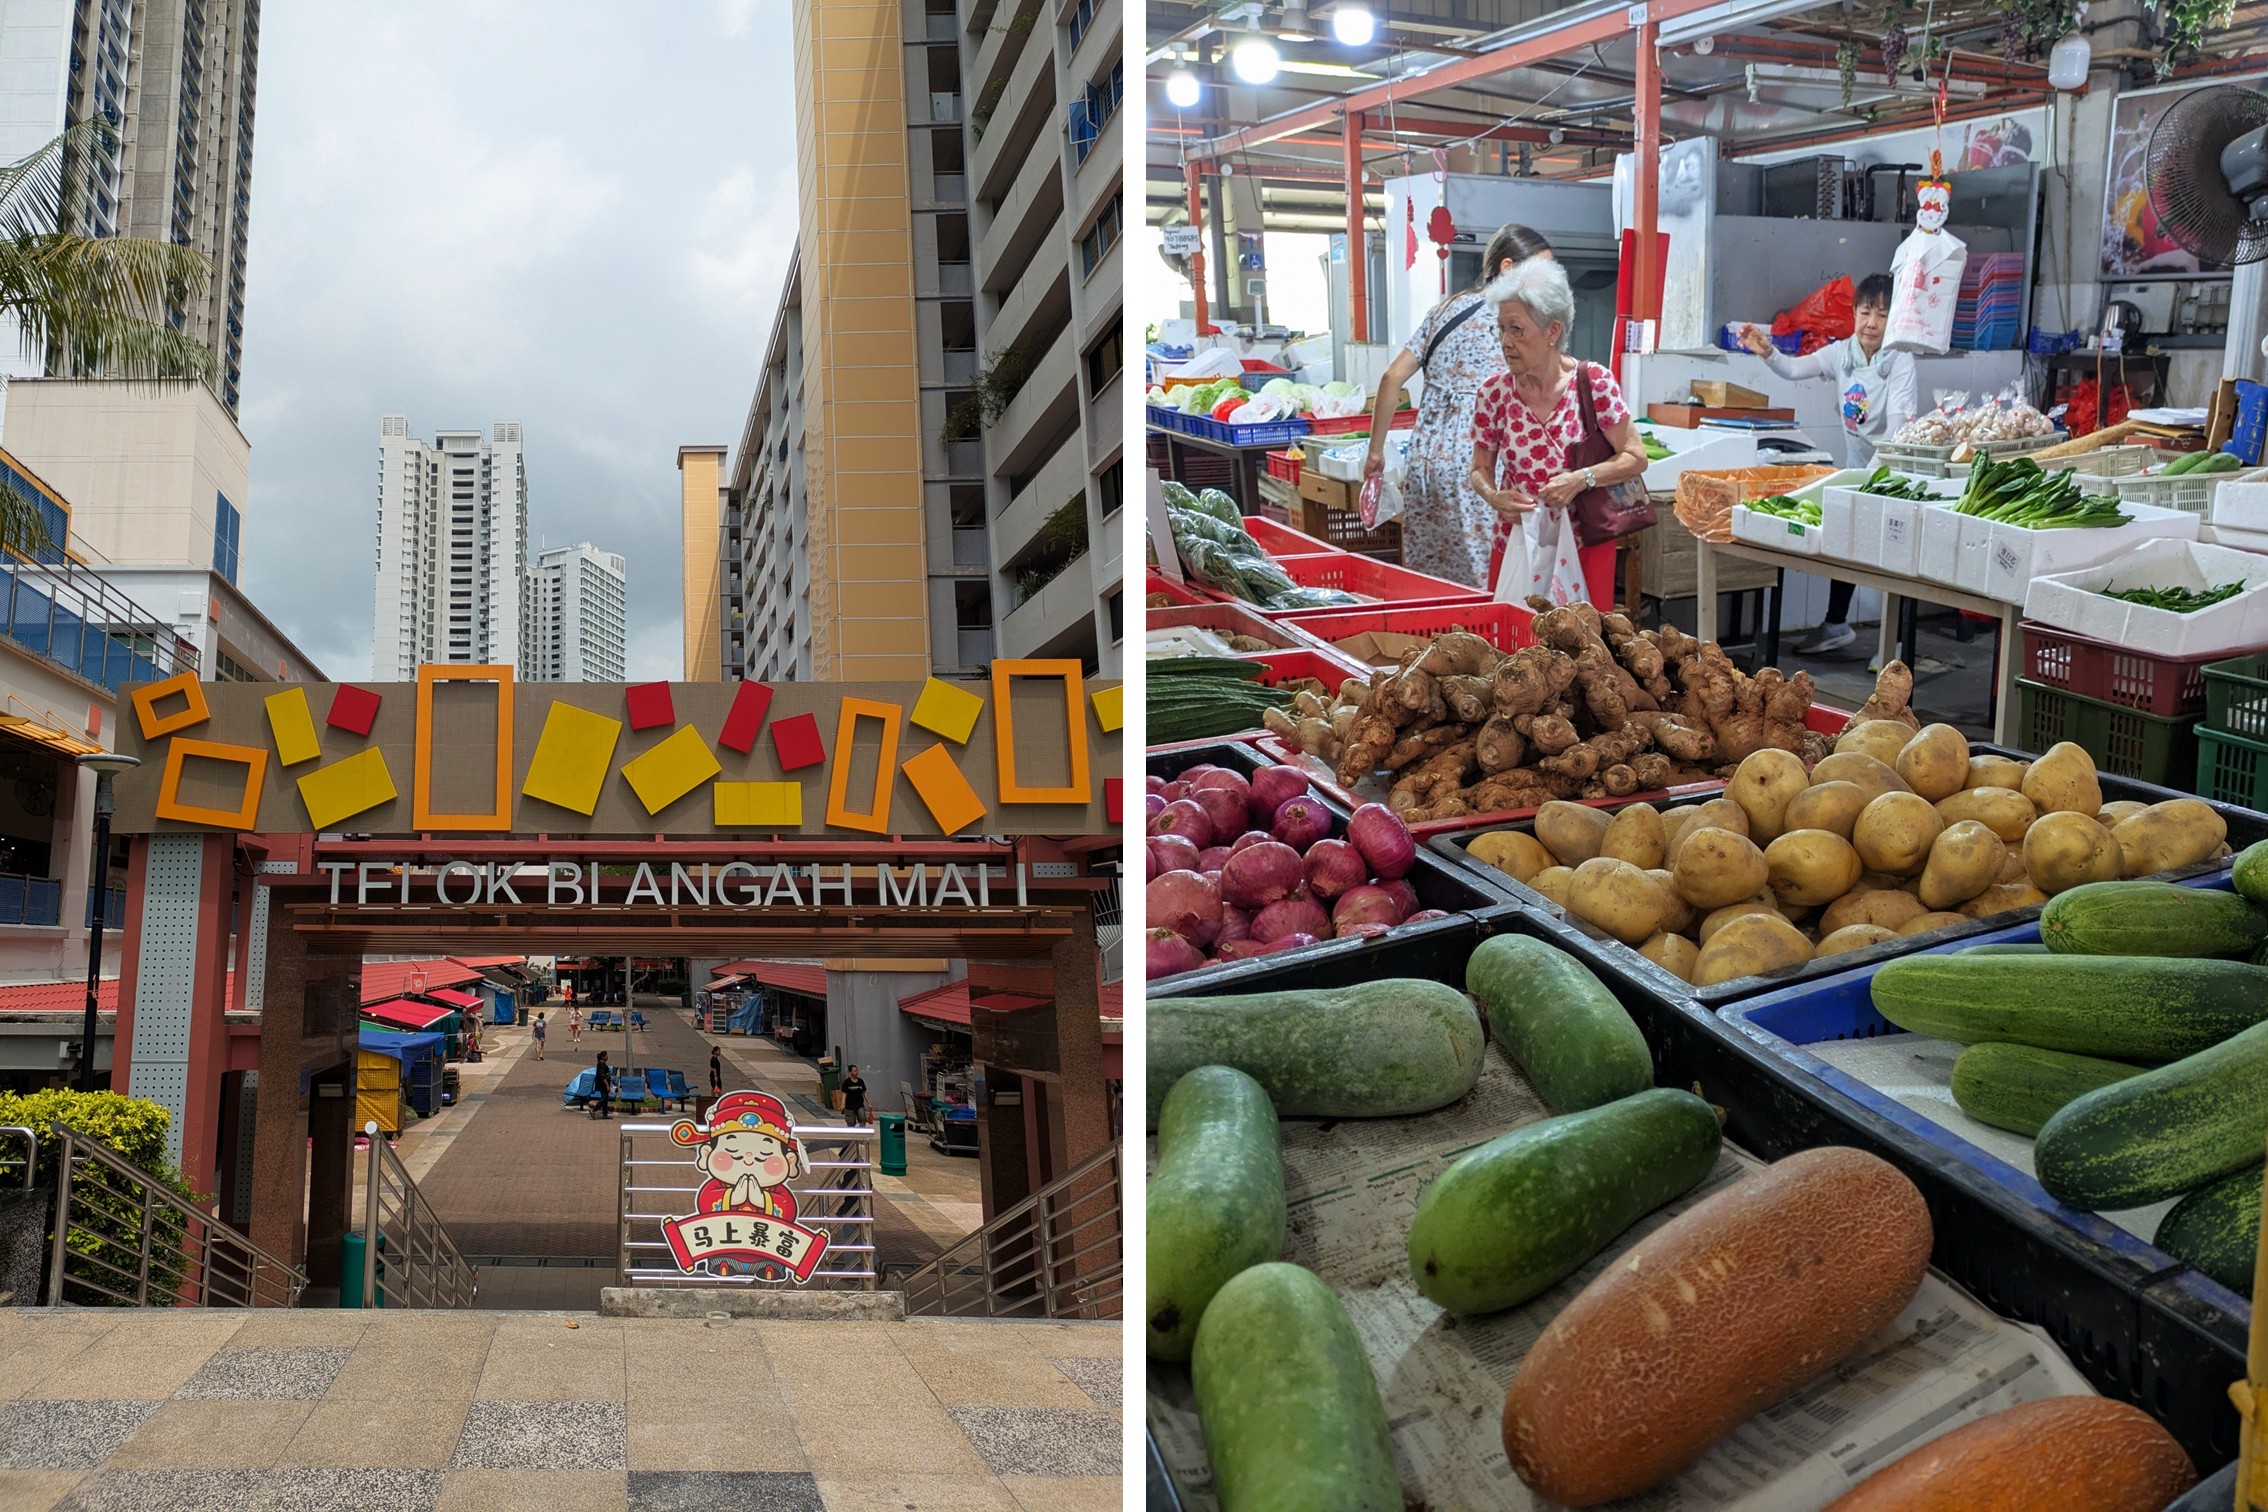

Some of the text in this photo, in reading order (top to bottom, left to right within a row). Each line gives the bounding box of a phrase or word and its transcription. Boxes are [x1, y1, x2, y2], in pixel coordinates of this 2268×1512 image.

[318, 861, 1051, 912] TELOK BLANGAH MALL
[693, 1222, 799, 1258] 马上暴富
